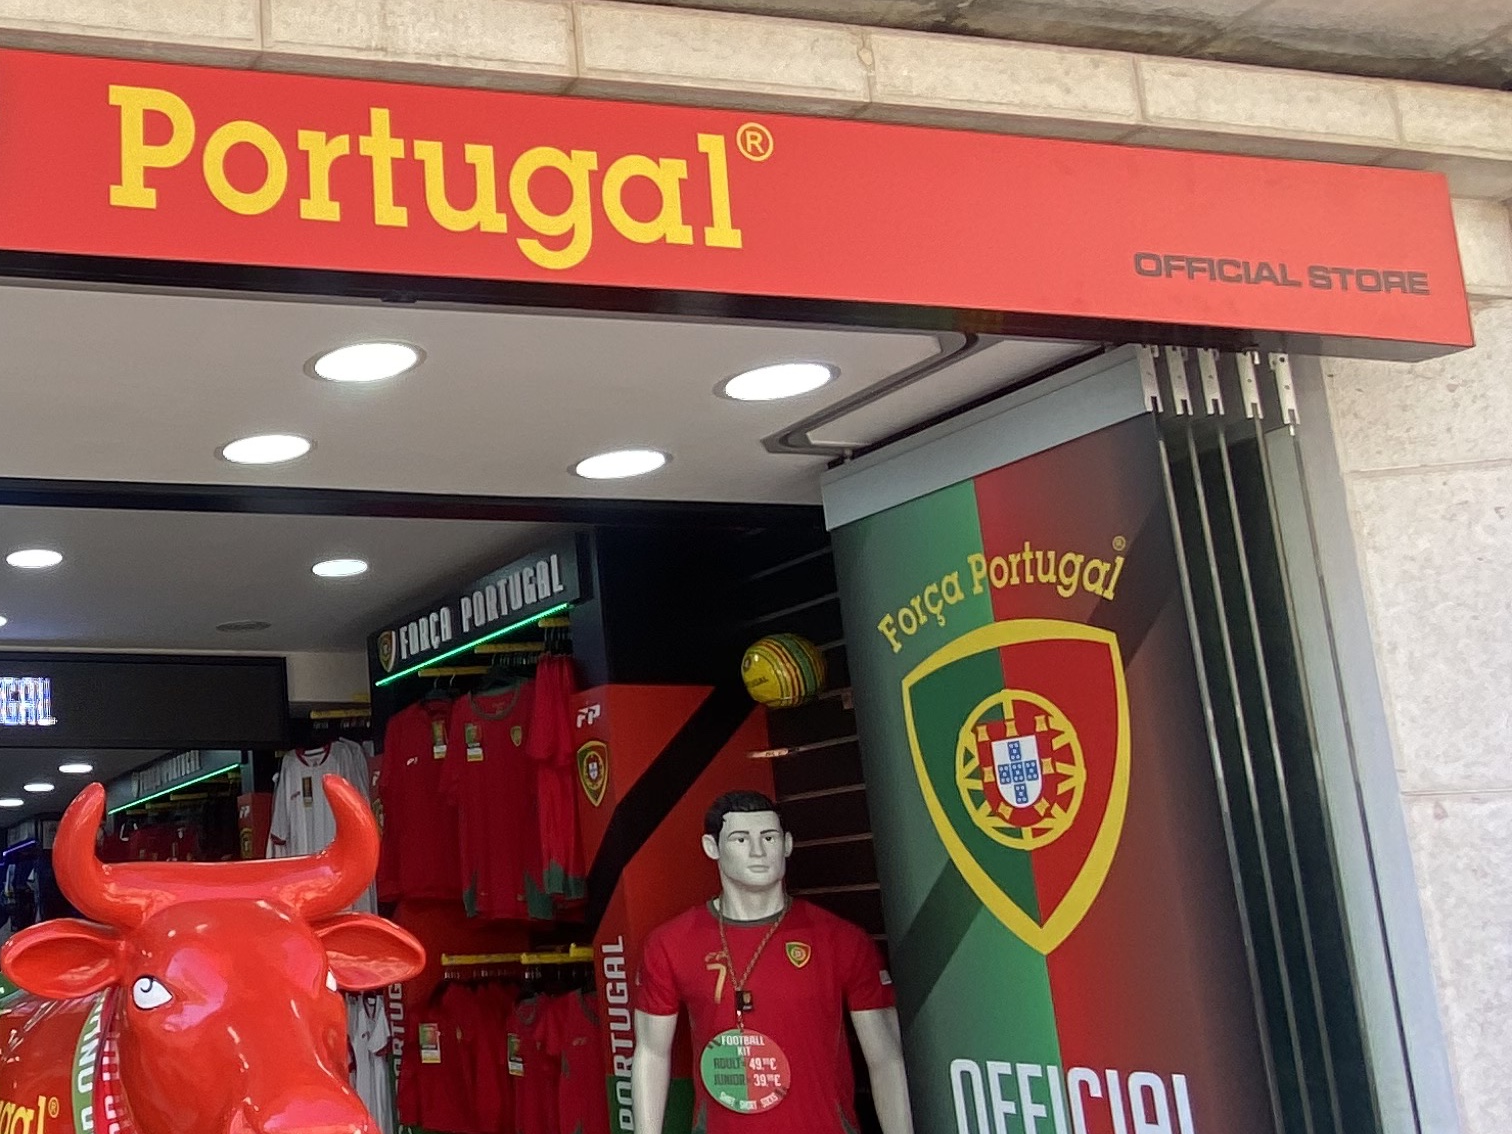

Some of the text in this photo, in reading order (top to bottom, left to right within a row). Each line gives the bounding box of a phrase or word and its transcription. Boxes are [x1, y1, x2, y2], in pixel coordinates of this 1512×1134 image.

[1133, 251, 1431, 296] OFFICIAL STORE
[398, 553, 565, 660] FORÇA PORTUGAL
[877, 570, 965, 654] Força
[720, 1035, 766, 1046] FOOTBALL
[736, 1046, 752, 1056] KIT
